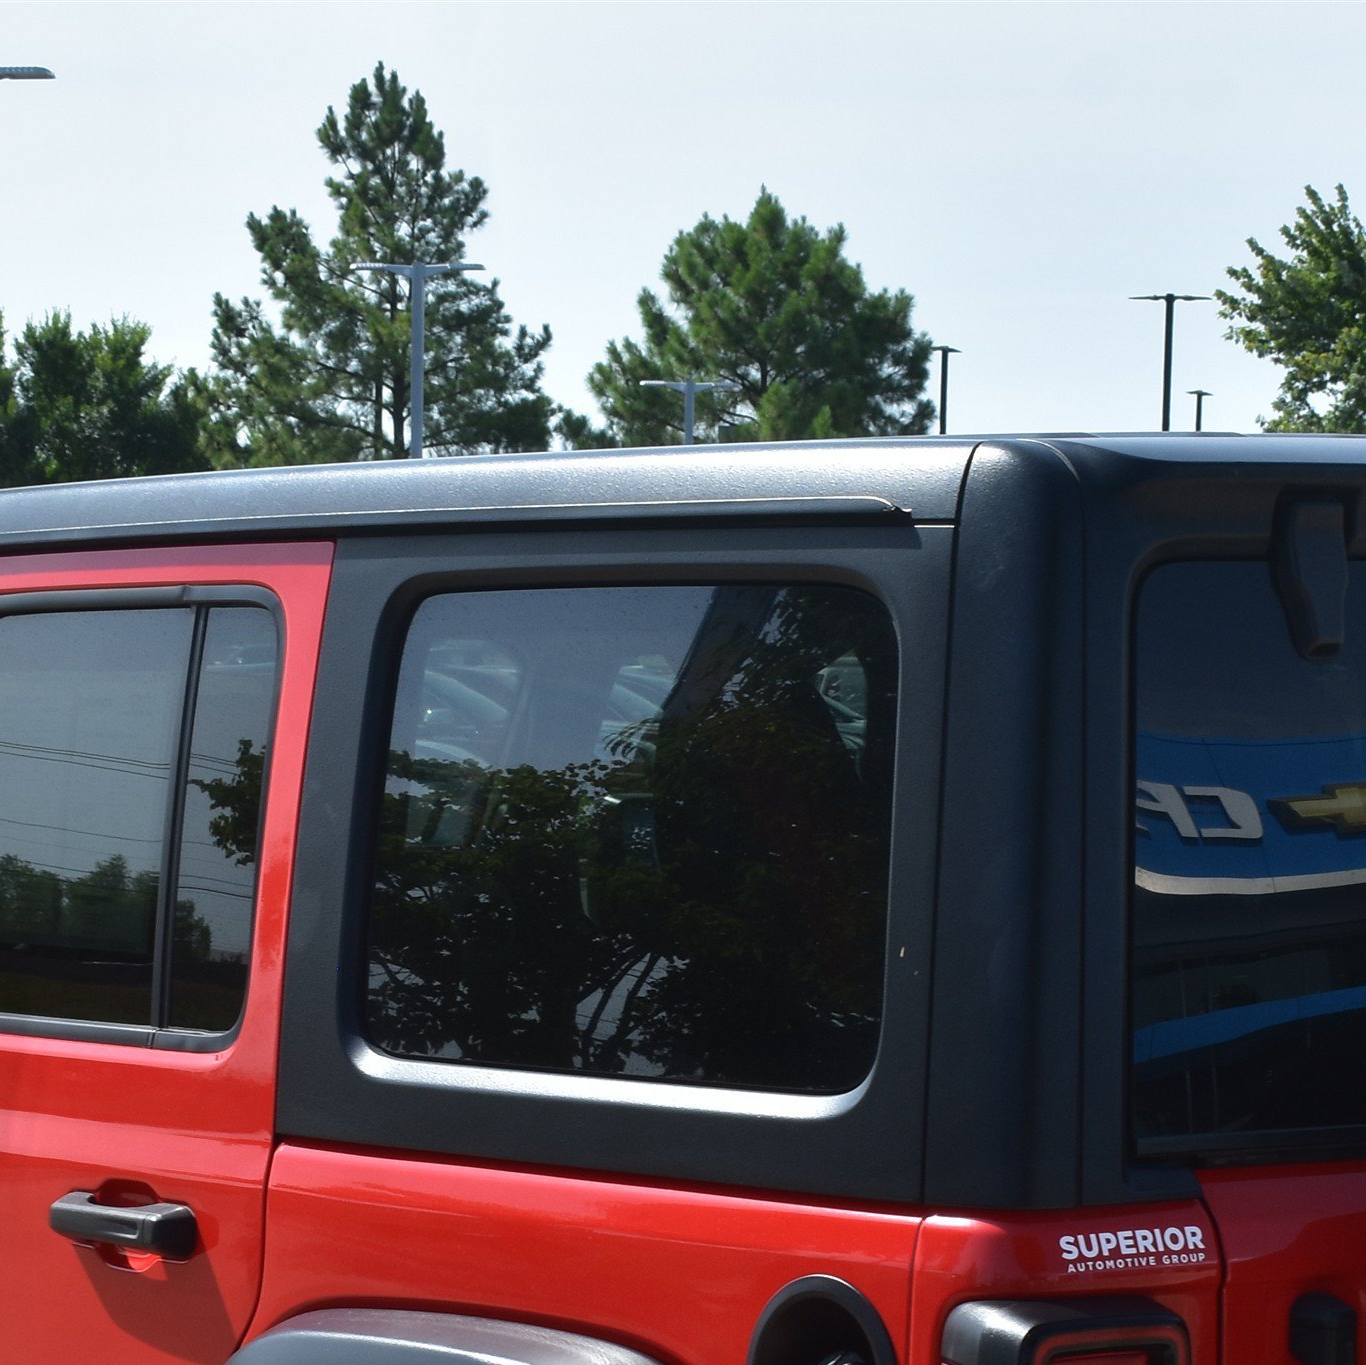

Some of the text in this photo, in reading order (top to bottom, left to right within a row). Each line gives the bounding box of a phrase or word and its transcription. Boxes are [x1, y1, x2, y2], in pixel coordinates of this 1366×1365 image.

[1059, 1225, 1206, 1260] SUPERIOR
[1067, 1252, 1206, 1273] AUTOMOTIVE GROUP
